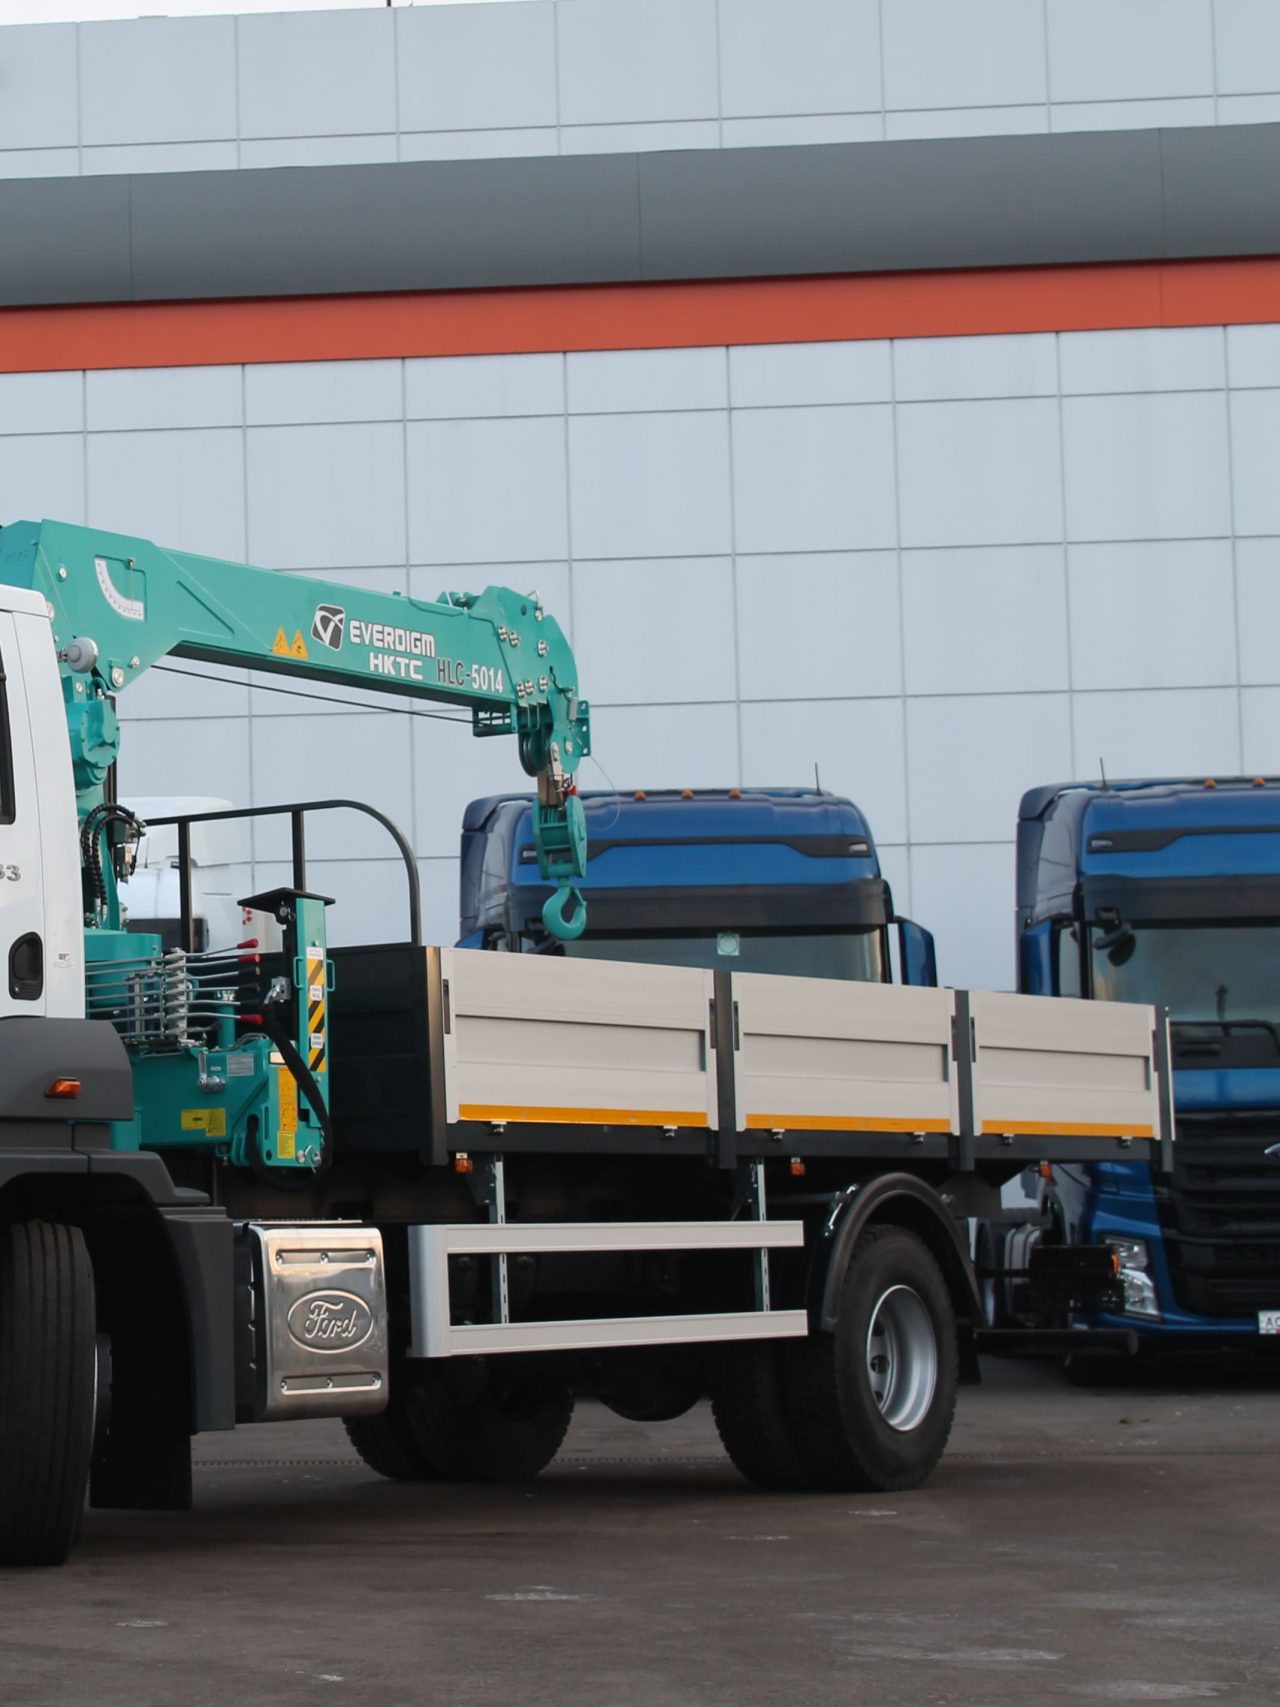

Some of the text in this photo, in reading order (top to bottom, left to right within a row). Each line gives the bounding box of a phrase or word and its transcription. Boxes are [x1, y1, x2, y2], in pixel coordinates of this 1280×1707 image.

[349, 620, 436, 657] EVERDIGM
[370, 652, 423, 680] HKTC
[437, 658, 504, 693] HLC-5014
[305, 1301, 356, 1338] Ford
